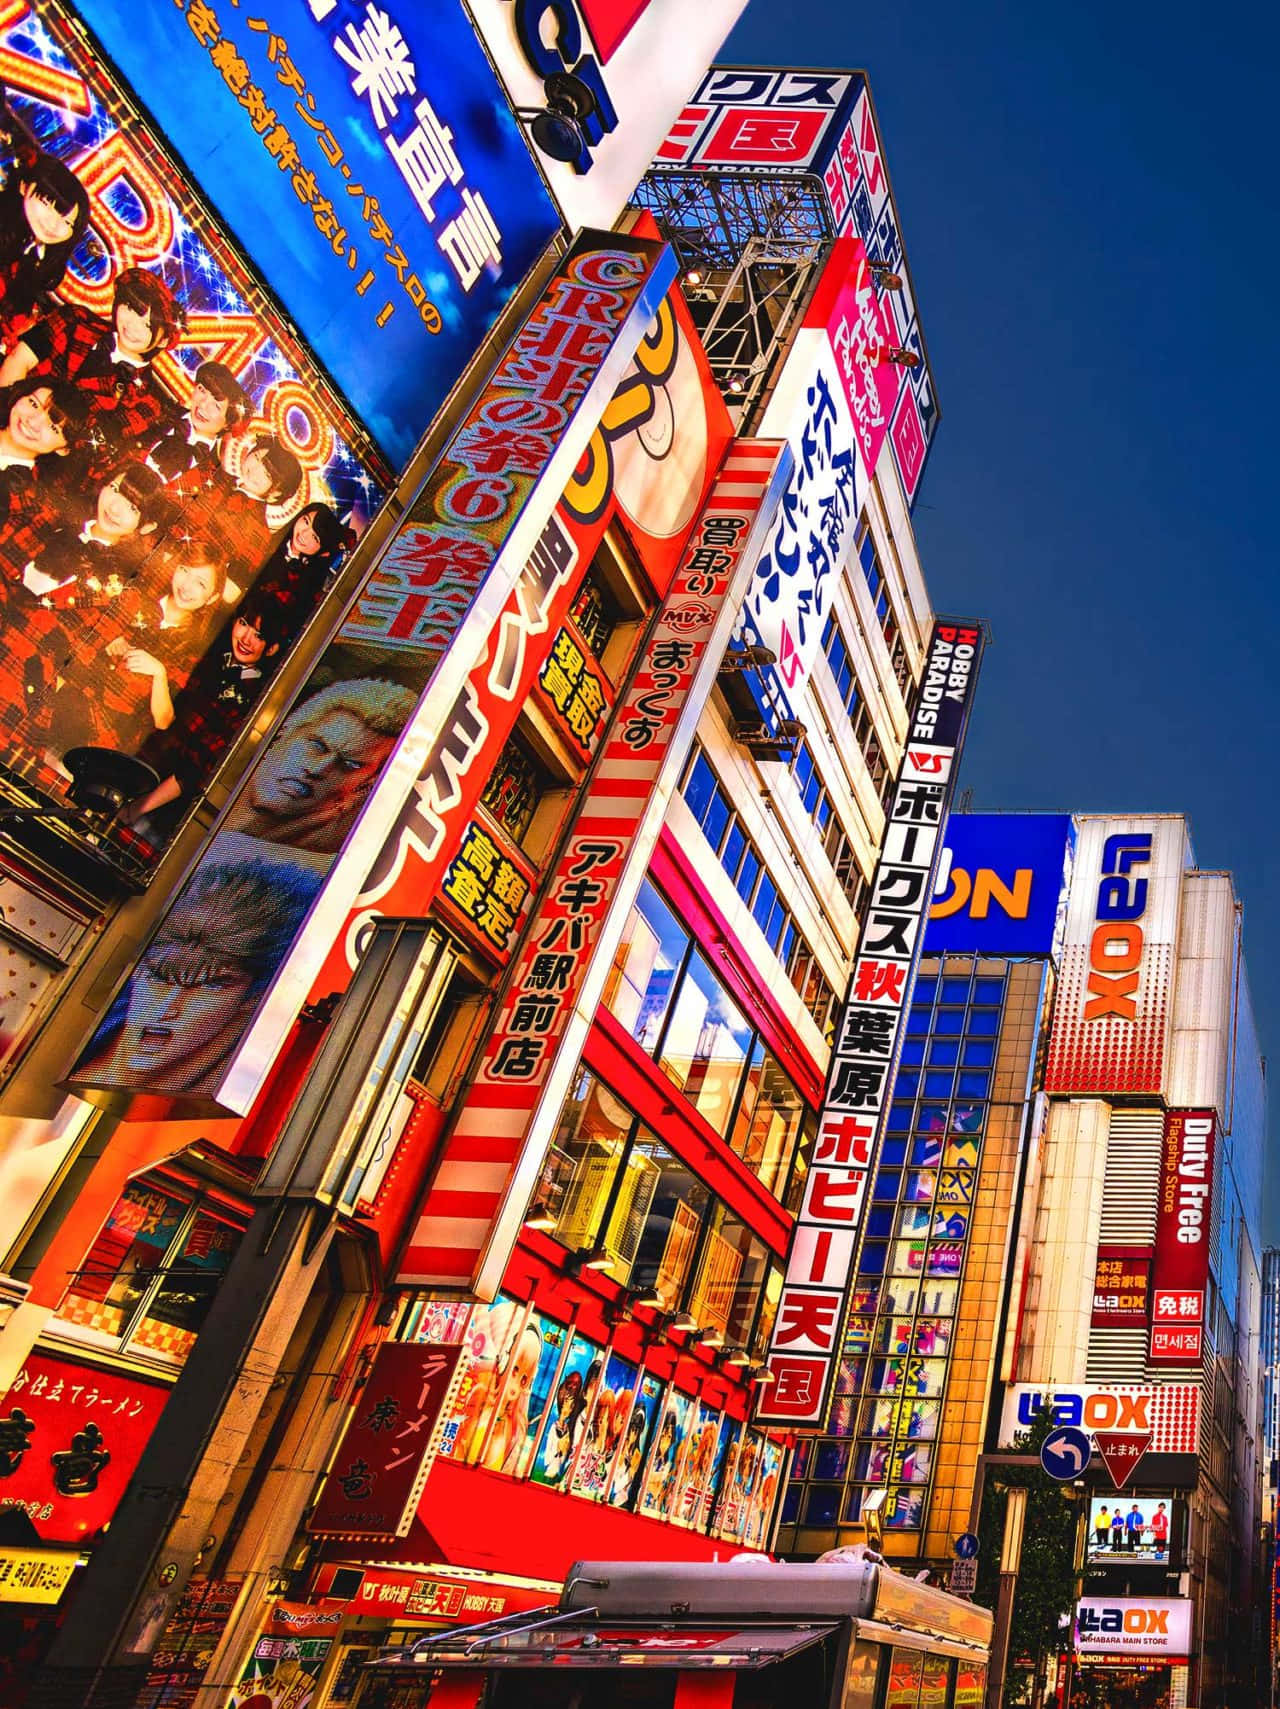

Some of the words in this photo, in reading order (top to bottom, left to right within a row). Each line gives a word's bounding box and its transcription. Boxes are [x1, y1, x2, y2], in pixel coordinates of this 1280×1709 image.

[684, 516, 746, 597] 買取り
[624, 640, 697, 751] まっくす
[912, 626, 958, 740] PARADISE
[945, 628, 980, 704] HOBBY
[490, 841, 619, 1083] アキバ駅前店
[758, 783, 945, 1421] ボークス秋葉原ホビー天国
[1163, 1117, 1183, 1172] Flagship
[1178, 1117, 1213, 1178] Duty
[1163, 1175, 1179, 1213] Store
[1176, 1183, 1209, 1245] Free
[1157, 1295, 1199, 1317] 免税
[1154, 1333, 1199, 1351] 면세점
[384, 1353, 449, 1472] ラーメン
[1104, 1444, 1141, 1457] 止まれ
[463, 1594, 489, 1611] HOBBY
[1121, 1636, 1142, 1646] MAIN
[1142, 1637, 1169, 1647] STORE
